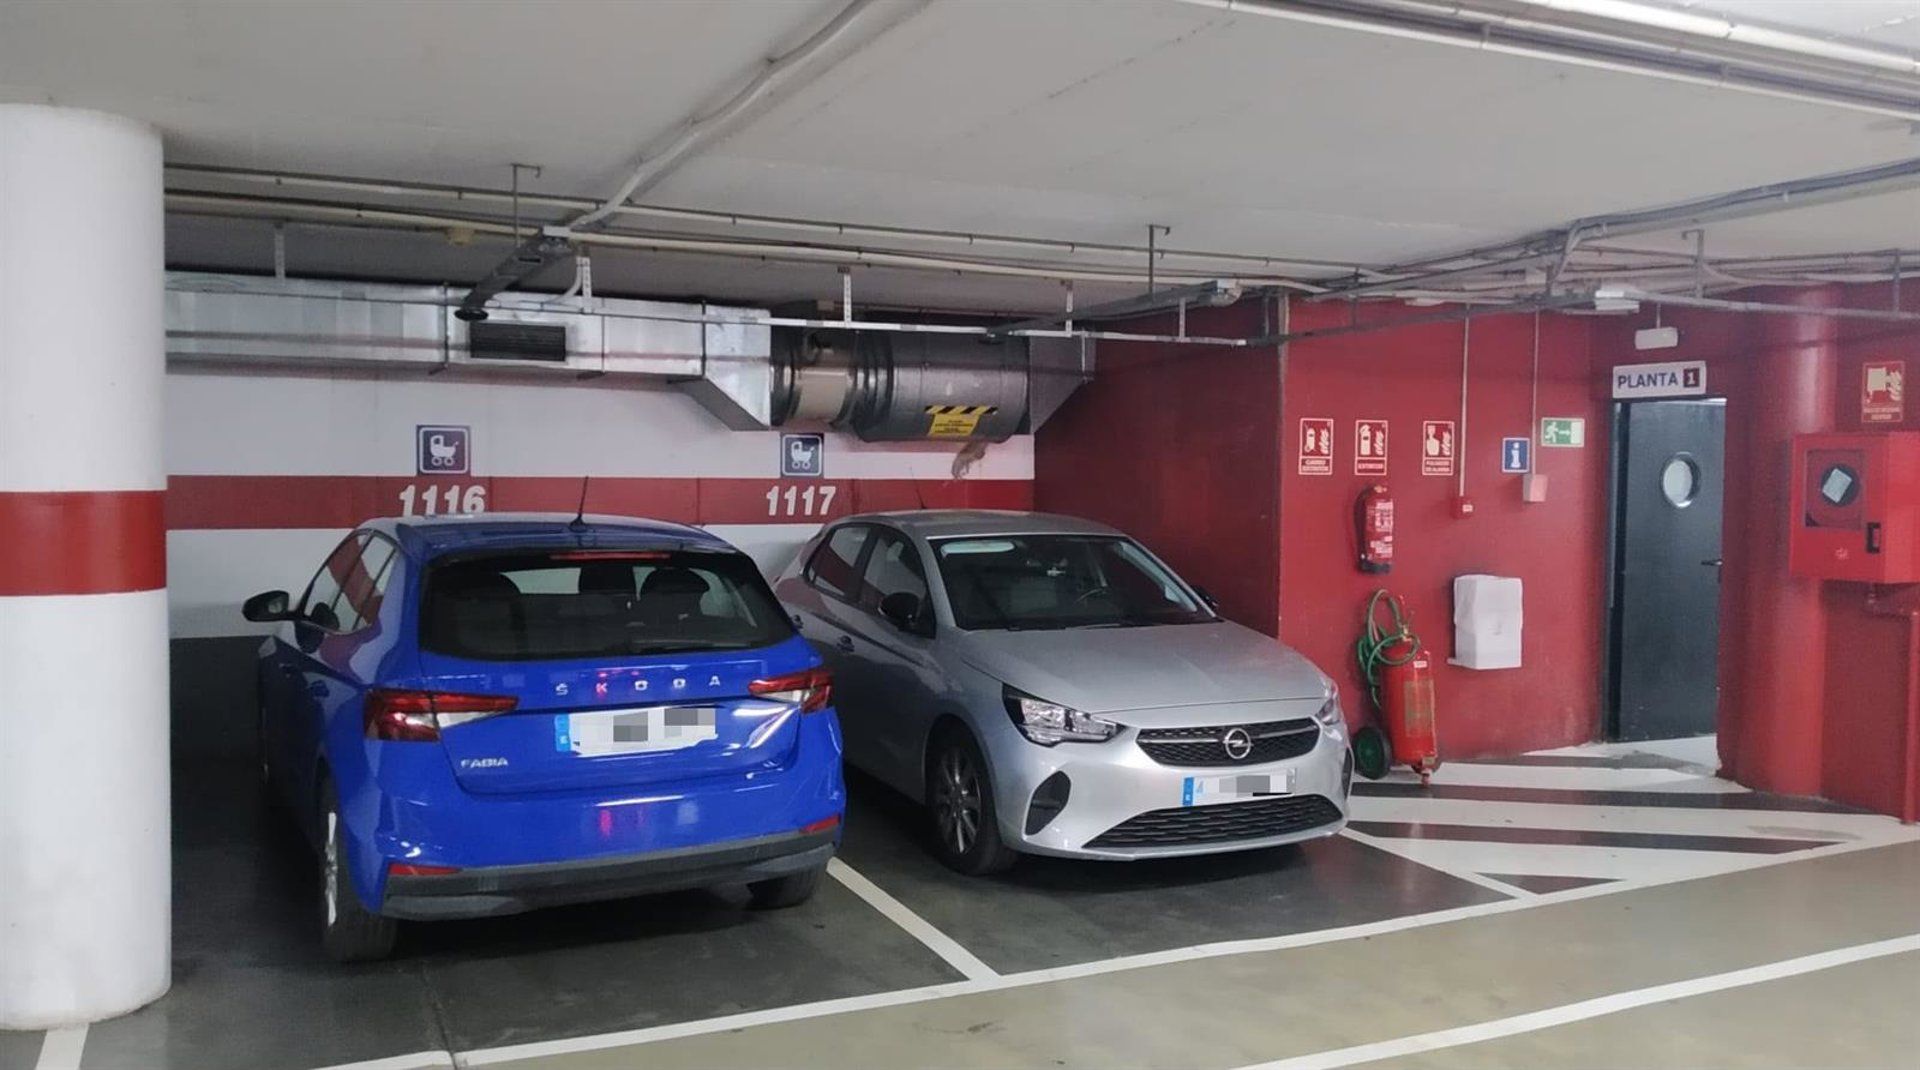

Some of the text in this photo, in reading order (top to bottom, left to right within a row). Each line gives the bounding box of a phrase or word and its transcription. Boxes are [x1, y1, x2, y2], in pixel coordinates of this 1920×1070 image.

[1617, 371, 1679, 389] PLANTA
[399, 485, 486, 517] 1116
[766, 486, 837, 516] 1117
[460, 757, 509, 768] FABIA
